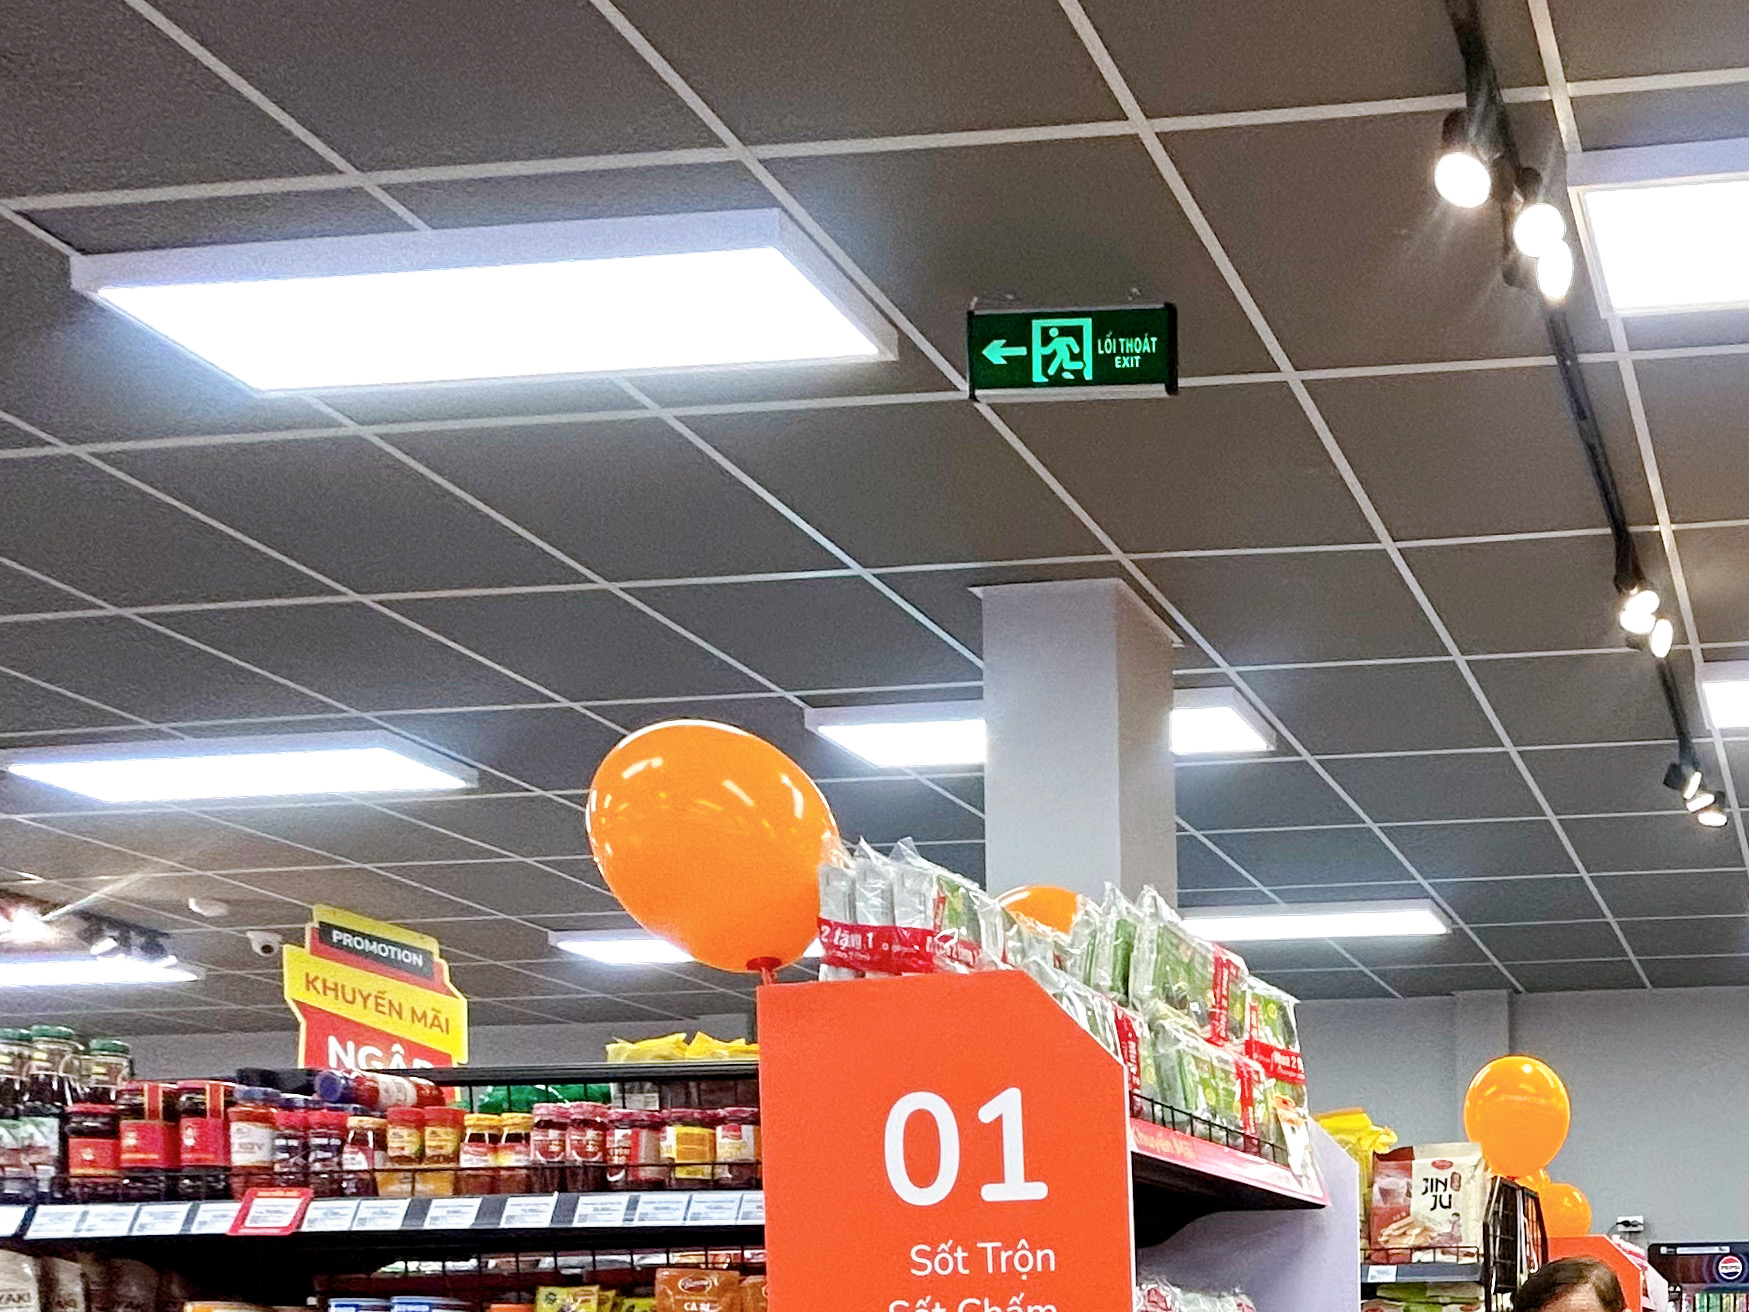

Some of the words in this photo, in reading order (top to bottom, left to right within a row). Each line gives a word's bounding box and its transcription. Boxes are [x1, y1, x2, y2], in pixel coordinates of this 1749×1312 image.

[1098, 331, 1116, 355] LỐI
[1119, 333, 1157, 354] THOÁT
[1115, 356, 1141, 369] EXIT
[332, 929, 424, 967] PROMOTION
[305, 972, 403, 1020] KHUYẾN
[411, 1007, 450, 1035] MÃI
[884, 1087, 1049, 1207] 01
[1421, 1176, 1448, 1195] JIN
[1430, 1193, 1453, 1211] JU
[910, 1239, 969, 1277] Sốt
[977, 1238, 1056, 1281] Trộn
